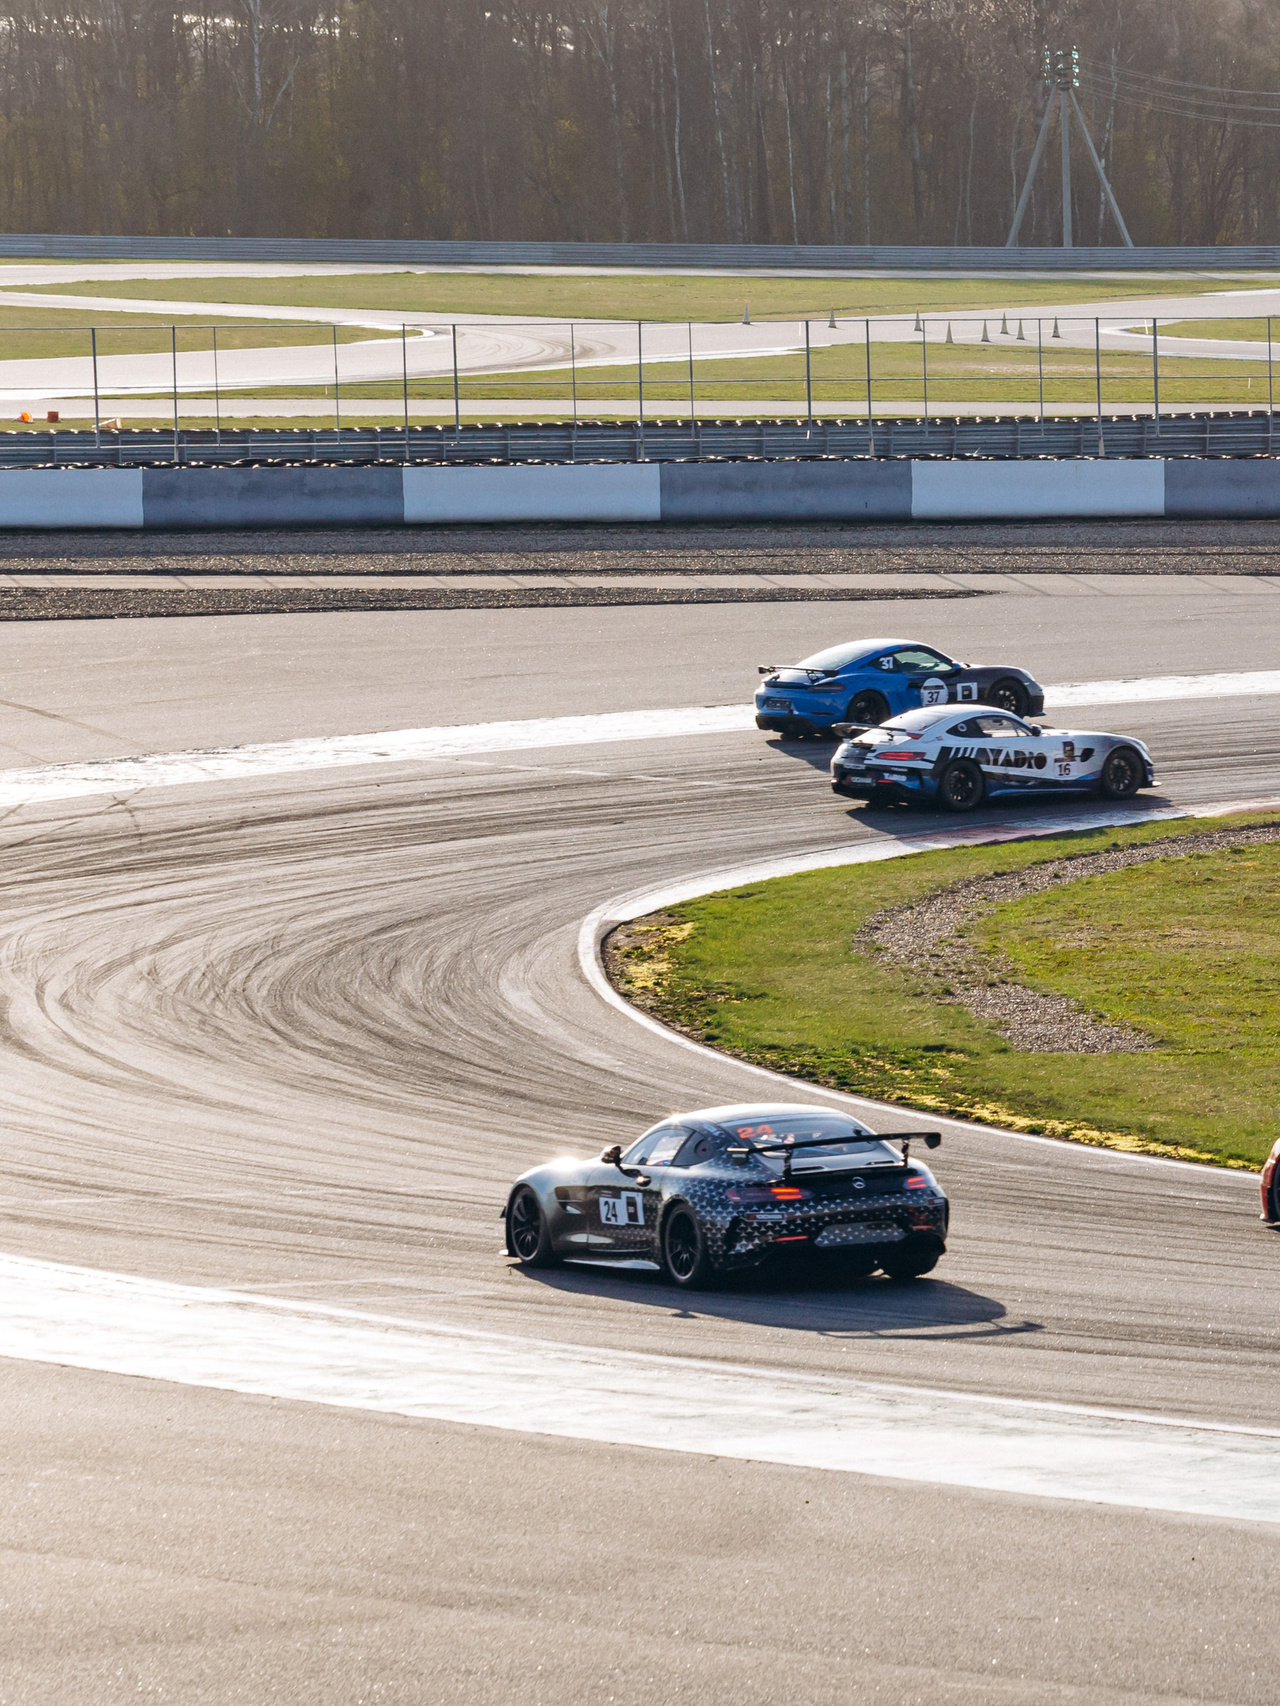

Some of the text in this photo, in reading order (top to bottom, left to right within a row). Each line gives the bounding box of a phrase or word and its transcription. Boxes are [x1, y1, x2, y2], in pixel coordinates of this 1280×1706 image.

[879, 656, 894, 669] 37
[927, 691, 940, 703] 37
[987, 748, 1047, 770] YADRO
[1058, 763, 1071, 776] 16
[737, 1123, 774, 1139] 24
[603, 1200, 618, 1223] 24
